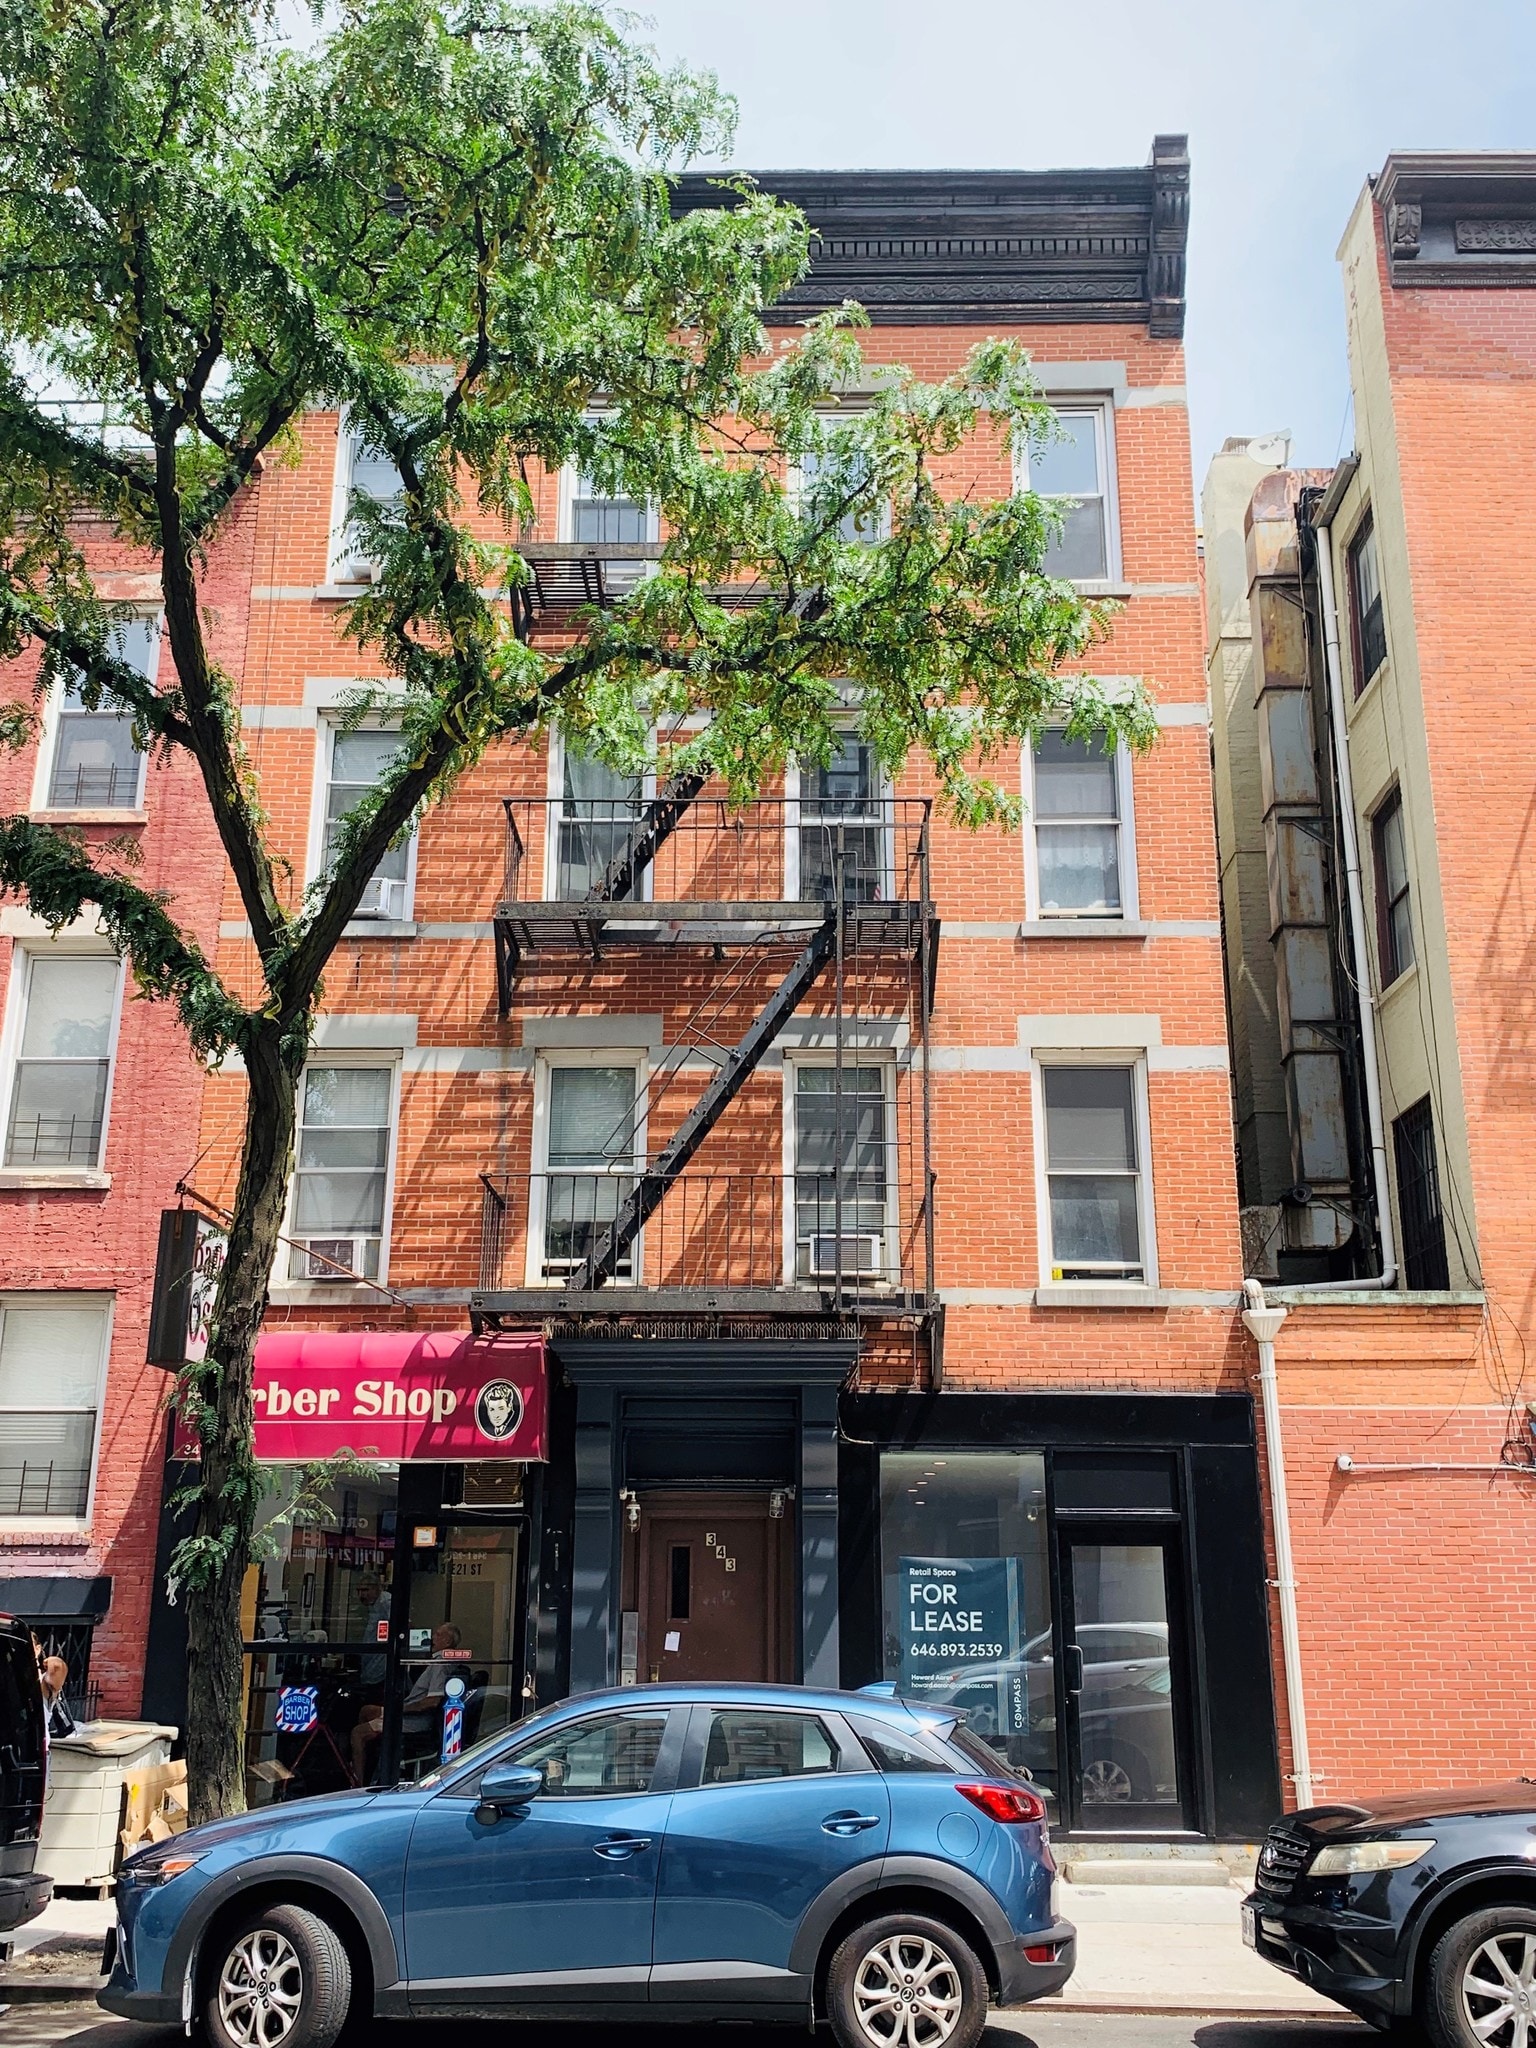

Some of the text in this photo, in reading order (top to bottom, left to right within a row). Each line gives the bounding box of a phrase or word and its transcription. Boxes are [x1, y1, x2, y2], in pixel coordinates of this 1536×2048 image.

[253, 1381, 457, 1423] rber Shop
[471, 1563, 482, 1575] ST
[909, 1567, 957, 1578] Retail Space
[909, 1583, 958, 1604] FOR
[910, 1611, 983, 1632] LEASE
[911, 1643, 1003, 1657] 646.893.2539
[911, 1673, 935, 1681] Howard
[284, 1695, 311, 1706] BARBER
[1014, 1678, 1022, 1729] COMPASS
[284, 1705, 309, 1721] SHOP
